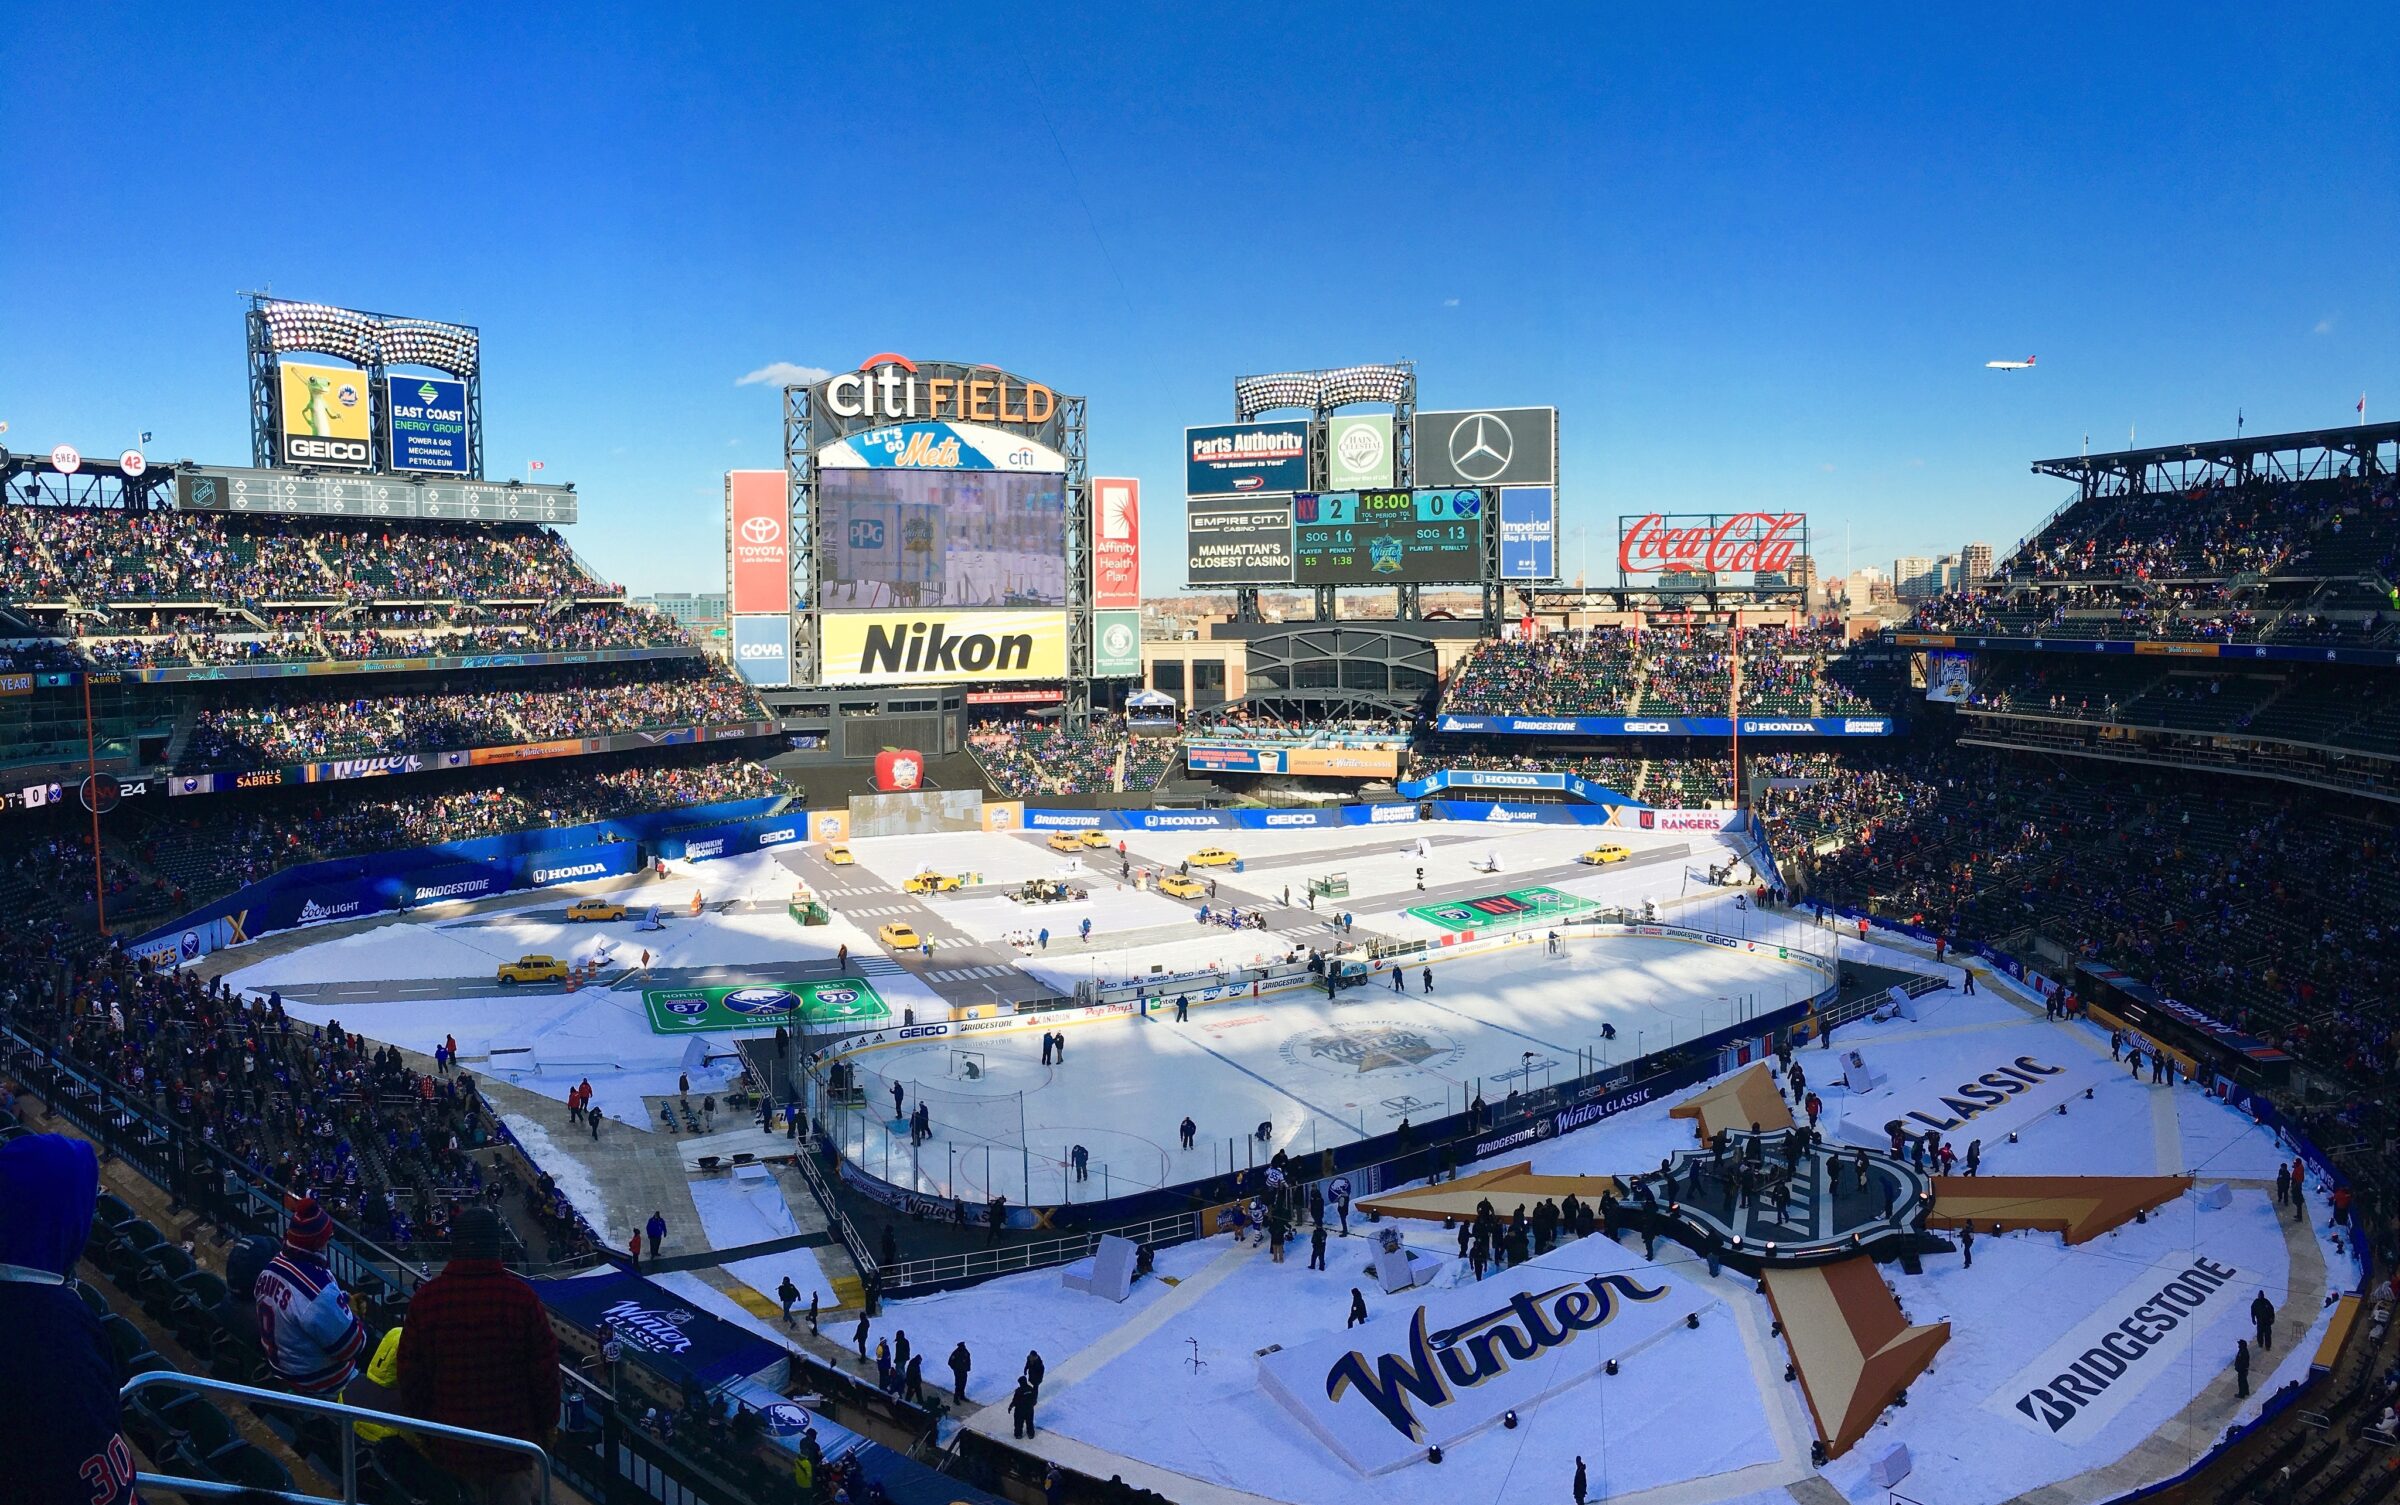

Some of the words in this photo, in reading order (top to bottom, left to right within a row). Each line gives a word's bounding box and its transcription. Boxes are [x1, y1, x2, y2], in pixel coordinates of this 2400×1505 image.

[827, 365, 915, 418] citi
[929, 378, 1054, 423] FIELD
[394, 405, 423, 419] EAST
[426, 408, 462, 422] COAST
[395, 421, 431, 432] ENERGY
[432, 423, 463, 434] GROUP
[408, 436, 432, 445] POWER
[433, 438, 437, 446] &
[438, 438, 452, 447] GAS
[863, 427, 903, 446] LET'S
[1193, 437, 1232, 454] Parts
[1234, 432, 1303, 452] Authority
[290, 439, 366, 461] GEICO
[408, 447, 452, 457] MECHANICAL
[885, 439, 905, 453] GO
[895, 431, 961, 468] Mets
[1339, 442, 1381, 450] CELESTIAL
[55, 453, 77, 465] SHEA
[124, 456, 142, 470] 42
[408, 458, 453, 467] PETROLEUM
[1009, 451, 1033, 466] citi
[280, 475, 331, 483] AMERICAN
[197, 486, 213, 500] NHL
[464, 485, 503, 493] NATIONAL
[1330, 500, 1342, 519] 2
[1431, 495, 1443, 515] 0
[1364, 494, 1410, 509] 18:00
[1195, 516, 1248, 526] EMPIRE
[1384, 519, 1389, 527] 1
[1502, 520, 1550, 533] Imperial
[1306, 533, 1328, 542] SOG
[1335, 529, 1353, 542] 16
[1417, 529, 1440, 538] SOG
[1448, 526, 1465, 539] 13
[1504, 534, 1519, 542] Bag
[738, 546, 784, 556] TOYOTA
[1098, 542, 1136, 556] Affinity
[1199, 544, 1281, 556] MANHATTAN'S
[1369, 546, 1403, 557] Winter
[1100, 557, 1134, 569] Health
[1190, 557, 1243, 568] CLOSEST
[1246, 556, 1290, 566] CASINO
[1305, 557, 1317, 566] 55
[1332, 557, 1353, 565] 1:38
[1106, 570, 1128, 582] Plan
[740, 643, 782, 657] GOYA
[859, 622, 1034, 674] Nikon
[0, 677, 30, 691] YEAR!
[88, 675, 121, 684] SABRES
[1513, 720, 1576, 731] BRIDGESTONE
[1624, 722, 1669, 732] GEICO
[1758, 723, 1815, 732] HONDA
[715, 729, 745, 738] RANGERS
[1336, 757, 1362, 768] Winter
[247, 769, 281, 777] BUFFALO
[236, 774, 282, 788] SABRES
[1485, 776, 1539, 785] HONDA
[32, 789, 39, 802] 0
[120, 782, 147, 797] 24
[1384, 805, 1416, 814] DUNKIN'
[1033, 814, 1100, 826] BRIDGESTONE
[1161, 816, 1219, 826] HONDA
[1266, 814, 1316, 825] GEICO
[1514, 812, 1537, 820] LIGHT
[1384, 813, 1415, 822] DONUTS
[1661, 819, 1720, 830] RANGERS
[759, 828, 796, 845] GEICO
[696, 838, 724, 850] DUNKIN'
[696, 847, 723, 858] DONUTS
[547, 863, 607, 879] HONDA
[415, 879, 490, 900] BRIDGESTONE
[302, 904, 331, 918] Coors
[332, 901, 359, 914] LIGHT
[1667, 928, 1702, 940] BRIDGESTONE
[1706, 935, 1737, 948] GEICO
[1148, 975, 1168, 983] GEICO
[1173, 971, 1193, 979] GEICO
[1262, 976, 1305, 990] BRIDGESTONE
[814, 982, 847, 990] WEST
[1203, 989, 1219, 999] SAP
[1229, 985, 1244, 994] SAP
[822, 993, 855, 1003] 90
[673, 1002, 701, 1013] 87
[1085, 1007, 1104, 1017] Pep
[1106, 1002, 1134, 1016] Boys
[746, 1015, 798, 1024] Buffalo
[1036, 1012, 1070, 1025] CANADIAN
[899, 1025, 948, 1039] GEICO
[960, 1020, 1014, 1032] BRIDGESTONE
[2128, 1029, 2157, 1057] Winter
[1490, 1060, 1560, 1082] GEICO
[1387, 1101, 1445, 1118] HONDA
[1476, 1127, 1535, 1156] BRIDGESTONE
[1555, 1103, 1605, 1136] Winter
[1606, 1088, 1651, 1113] CLASSIC
[1270, 1172, 1279, 1181] 55
[2309, 1156, 2335, 1191] DISCOVER
[851, 1174, 890, 1201] BRIDGESTONE
[905, 1193, 950, 1219] Winter
[600, 1300, 692, 1353] Winter
[605, 1316, 669, 1353] CLASSIC
[2015, 1256, 2237, 1433] BRIDGESTONE
[1326, 1274, 1671, 1445] Winter
[79, 1433, 134, 1505] 30
